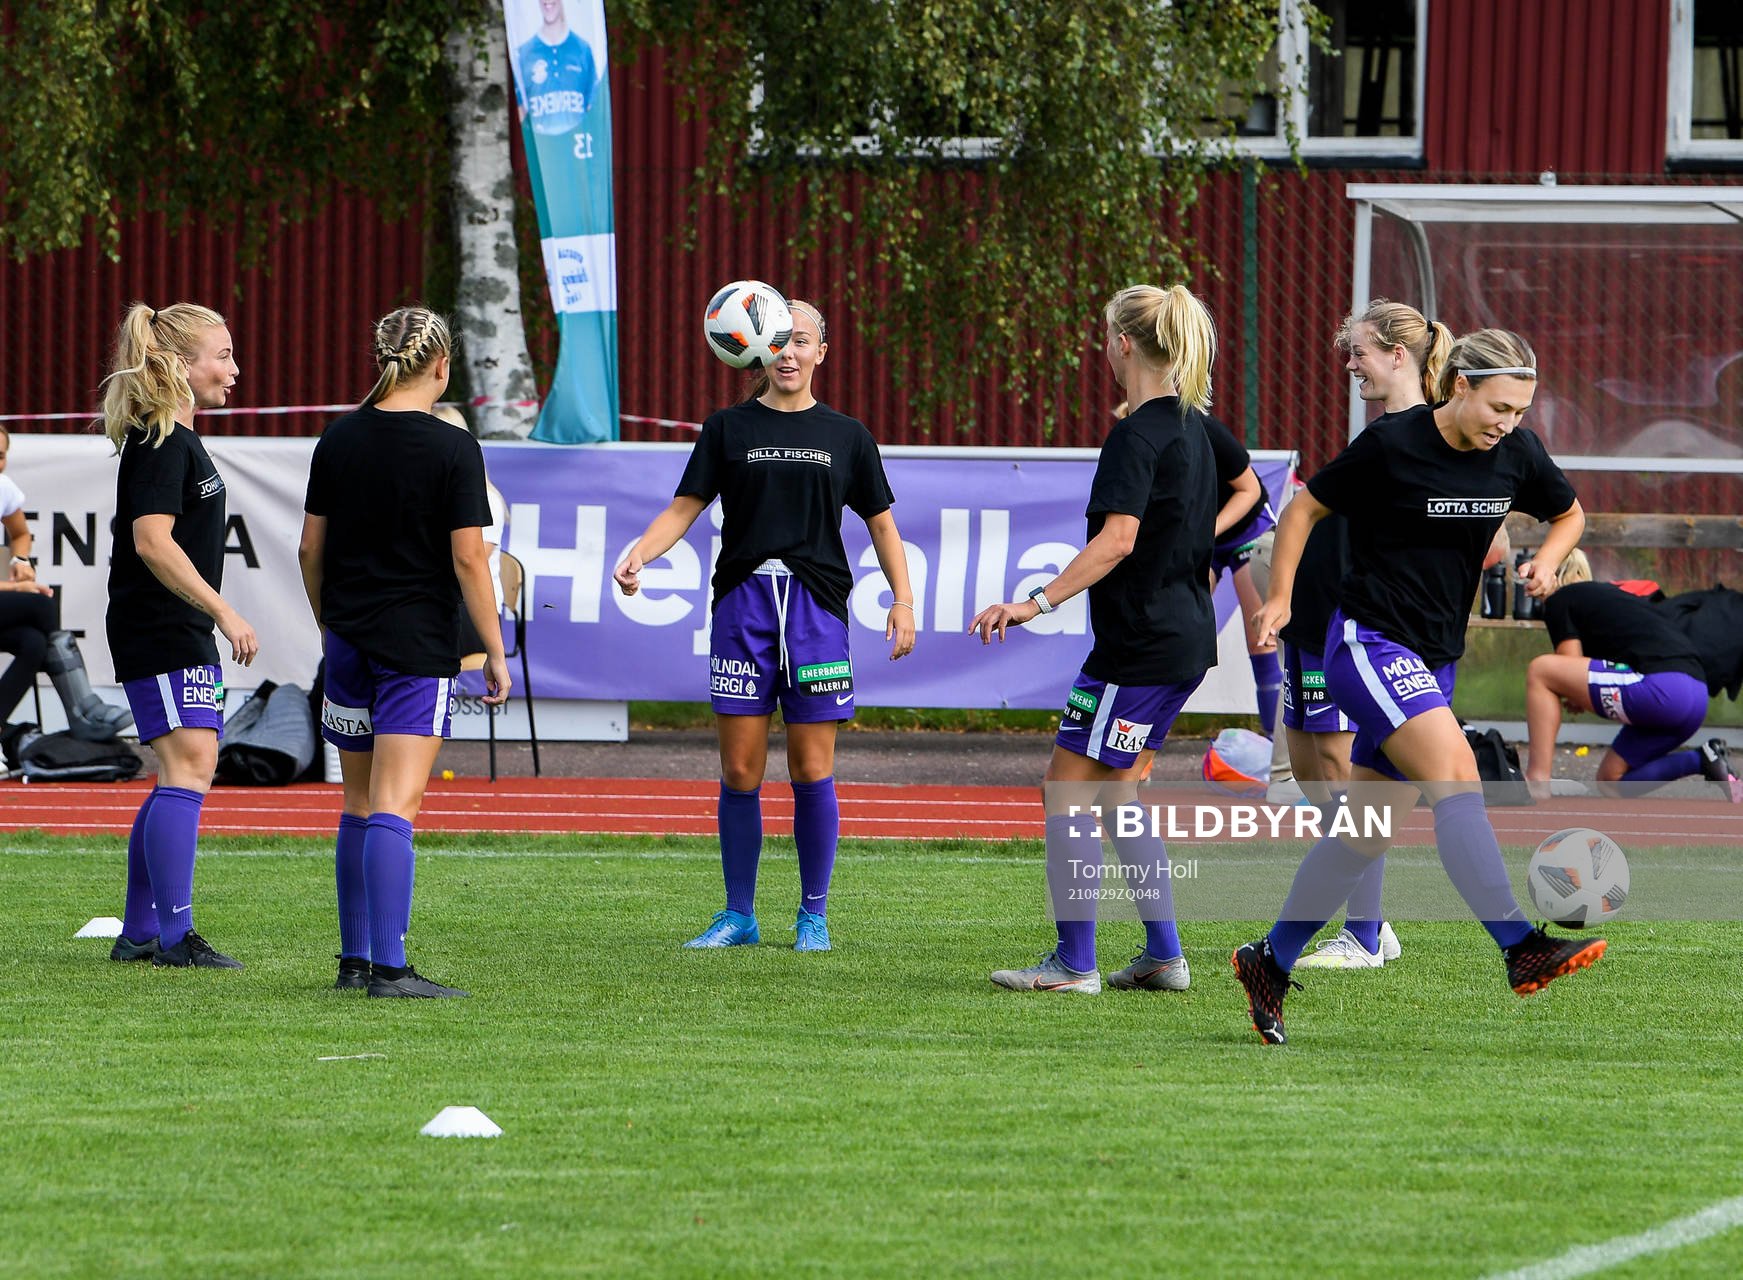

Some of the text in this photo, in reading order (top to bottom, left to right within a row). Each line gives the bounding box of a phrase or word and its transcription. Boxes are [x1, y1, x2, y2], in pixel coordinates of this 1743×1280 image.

[747, 450, 831, 464] NILLA FISCHER
[1427, 502, 1468, 514] LOTTA
[810, 681, 841, 693] MÅLERI
[1312, 691, 1325, 701] AB
[323, 708, 371, 734] RASTA
[1114, 731, 1149, 751] RAS
